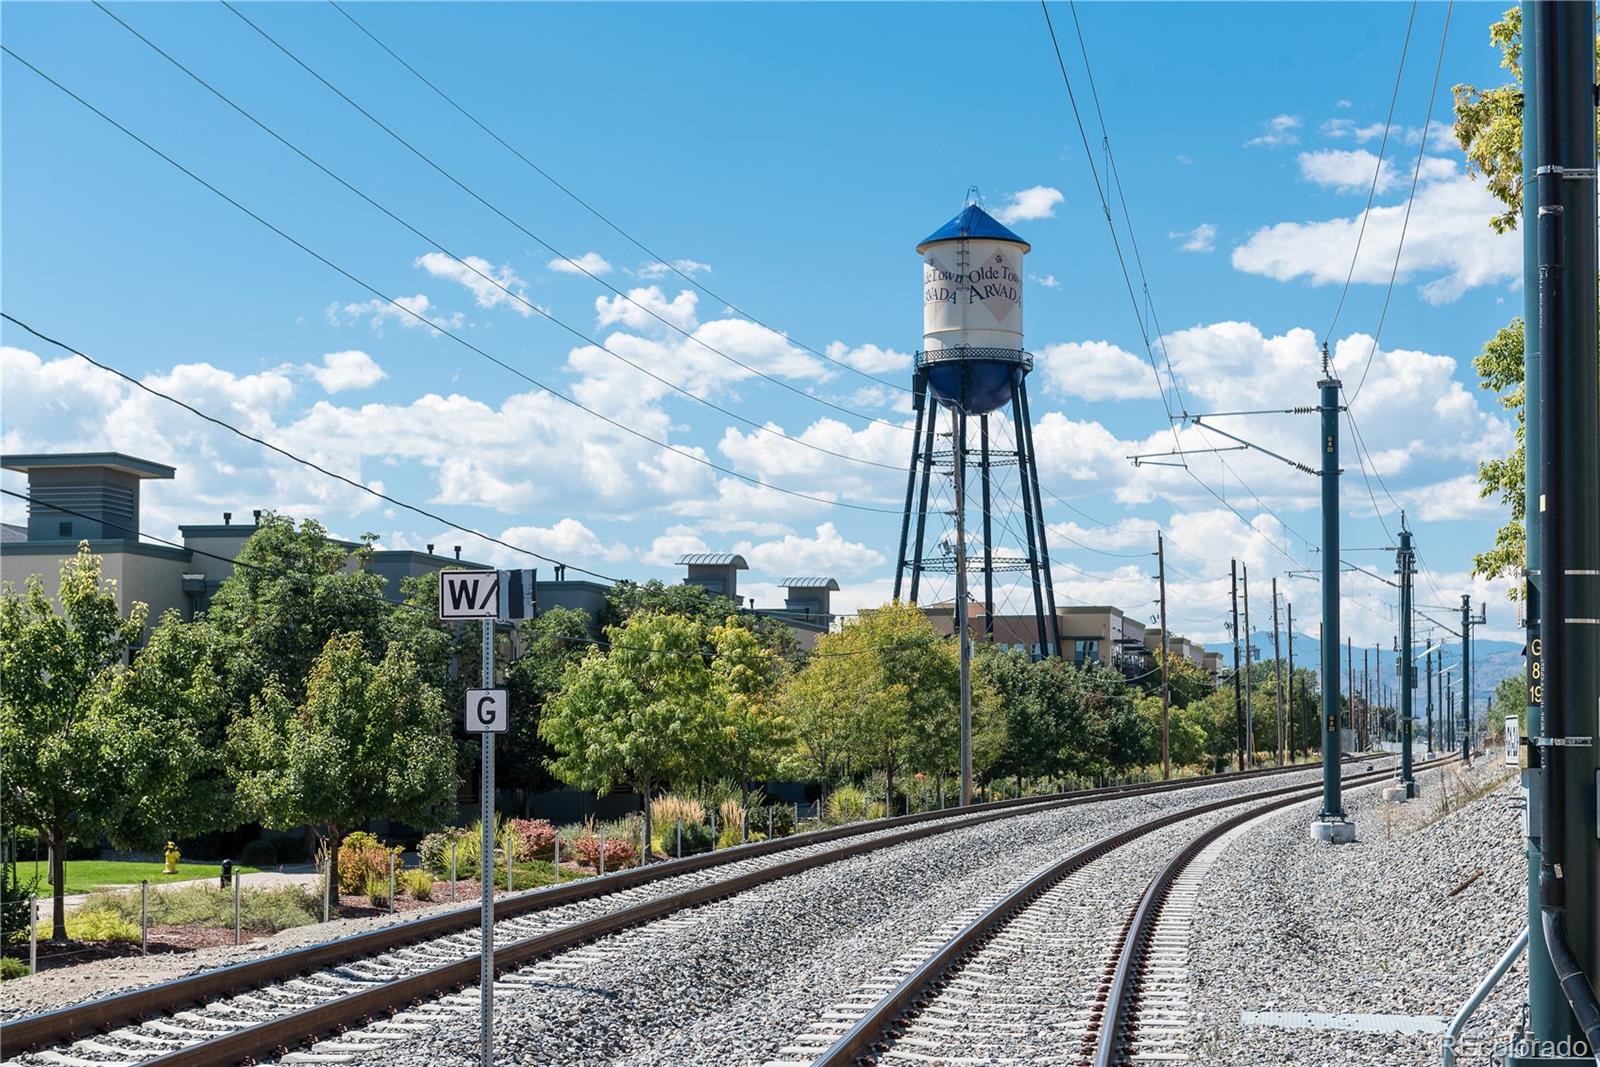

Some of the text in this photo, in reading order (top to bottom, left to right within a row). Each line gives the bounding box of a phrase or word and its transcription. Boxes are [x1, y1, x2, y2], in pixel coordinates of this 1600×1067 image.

[969, 266, 999, 283] Olde
[1531, 639, 1541, 656] G
[1532, 662, 1541, 680] 8
[1530, 685, 1542, 703] 19
[477, 696, 496, 725] G
